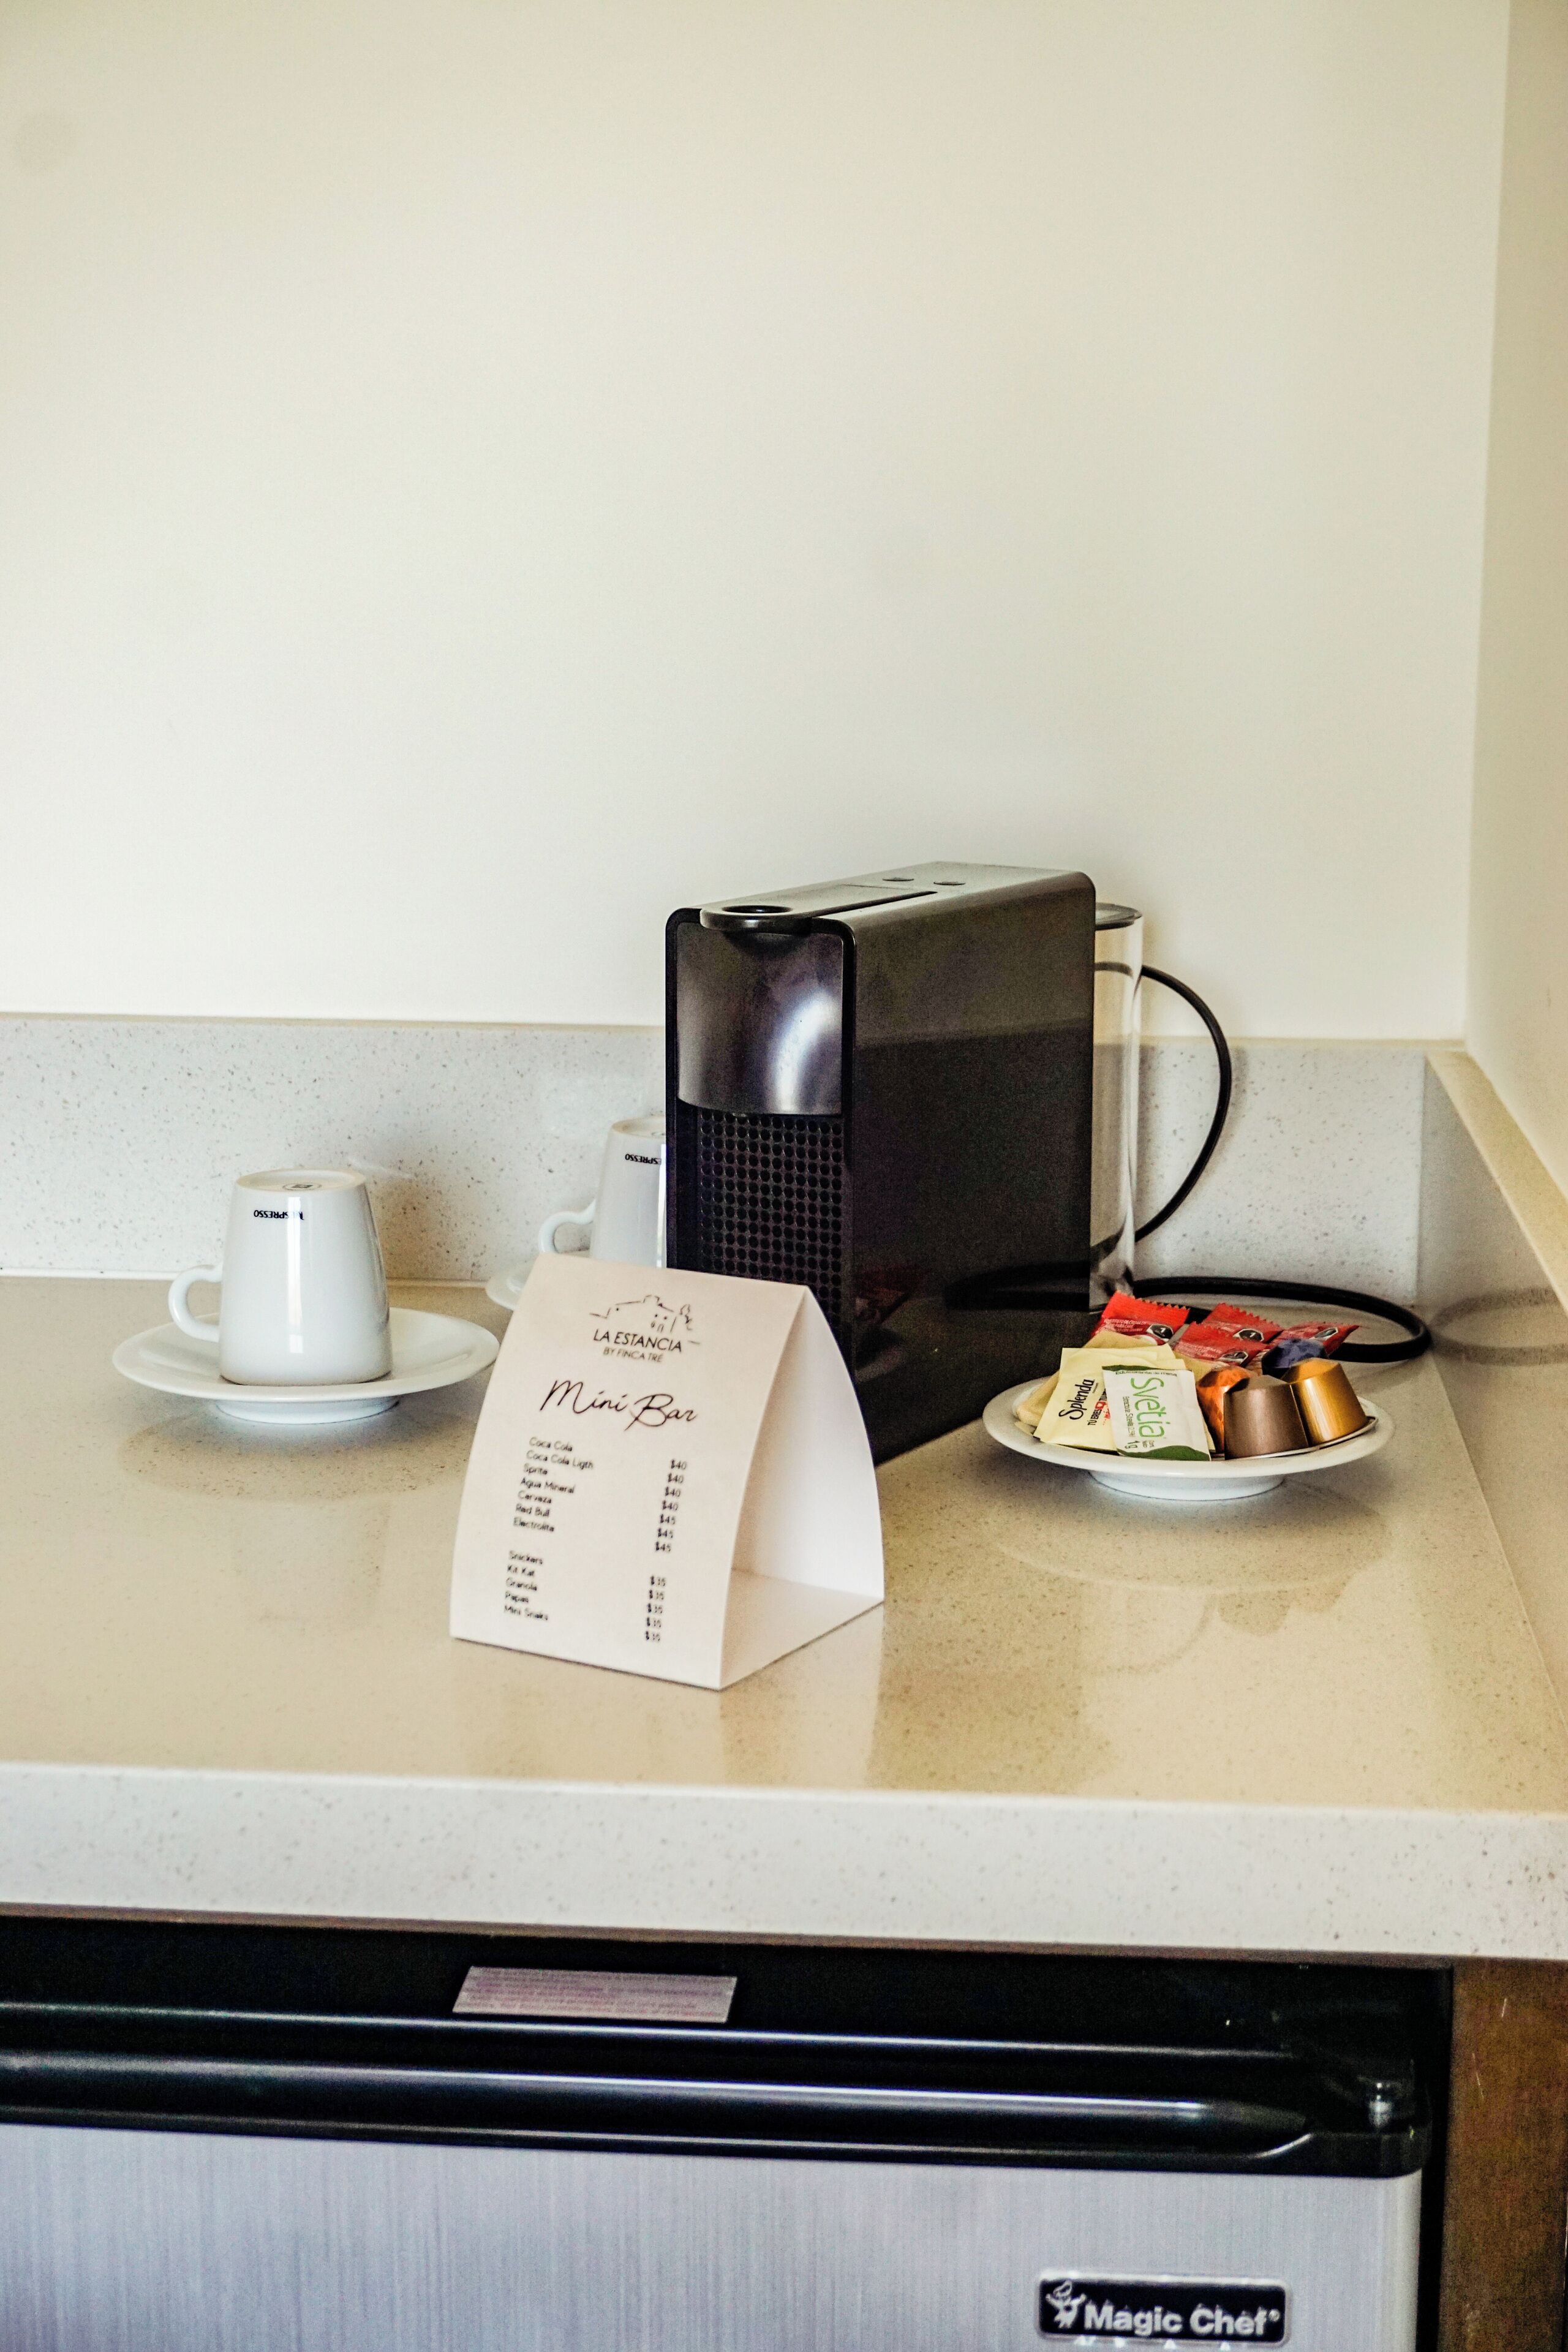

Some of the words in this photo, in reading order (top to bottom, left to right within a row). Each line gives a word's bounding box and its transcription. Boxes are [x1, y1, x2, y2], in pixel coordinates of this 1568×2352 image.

[594, 1329, 609, 1342] LA
[614, 1332, 682, 1352] ESTANCIA
[603, 1346, 615, 1355] BY
[617, 1349, 645, 1360] FINCA
[540, 1379, 628, 1414] Mini
[624, 1393, 697, 1431] Bar
[1058, 1379, 1095, 1420] Splenda
[1130, 1378, 1170, 1438] Svetia
[526, 1450, 548, 1461] Coca
[551, 1454, 570, 1465] Cola
[668, 1473, 684, 1483] $40
[529, 1436, 551, 1449] Coca
[554, 1441, 573, 1452] Cola
[671, 1460, 687, 1470] $40
[521, 1477, 541, 1489] Agua
[545, 1481, 576, 1493] Mineral
[662, 1500, 678, 1510] $40
[524, 1463, 548, 1475] Sprite
[665, 1487, 681, 1497] $40
[516, 1503, 532, 1514] Red
[535, 1507, 550, 1517] Bull
[657, 1528, 673, 1538] $45
[518, 1490, 552, 1504] Cerveza
[660, 1514, 676, 1525] $45
[509, 1550, 543, 1565] Snickers
[655, 1541, 671, 1551] $45
[506, 1577, 537, 1591] Granola
[507, 1564, 518, 1573] Kit
[504, 1605, 521, 1615] Mini
[1084, 2301, 1183, 2337] Magic
[1190, 2304, 1267, 2336] Chef
